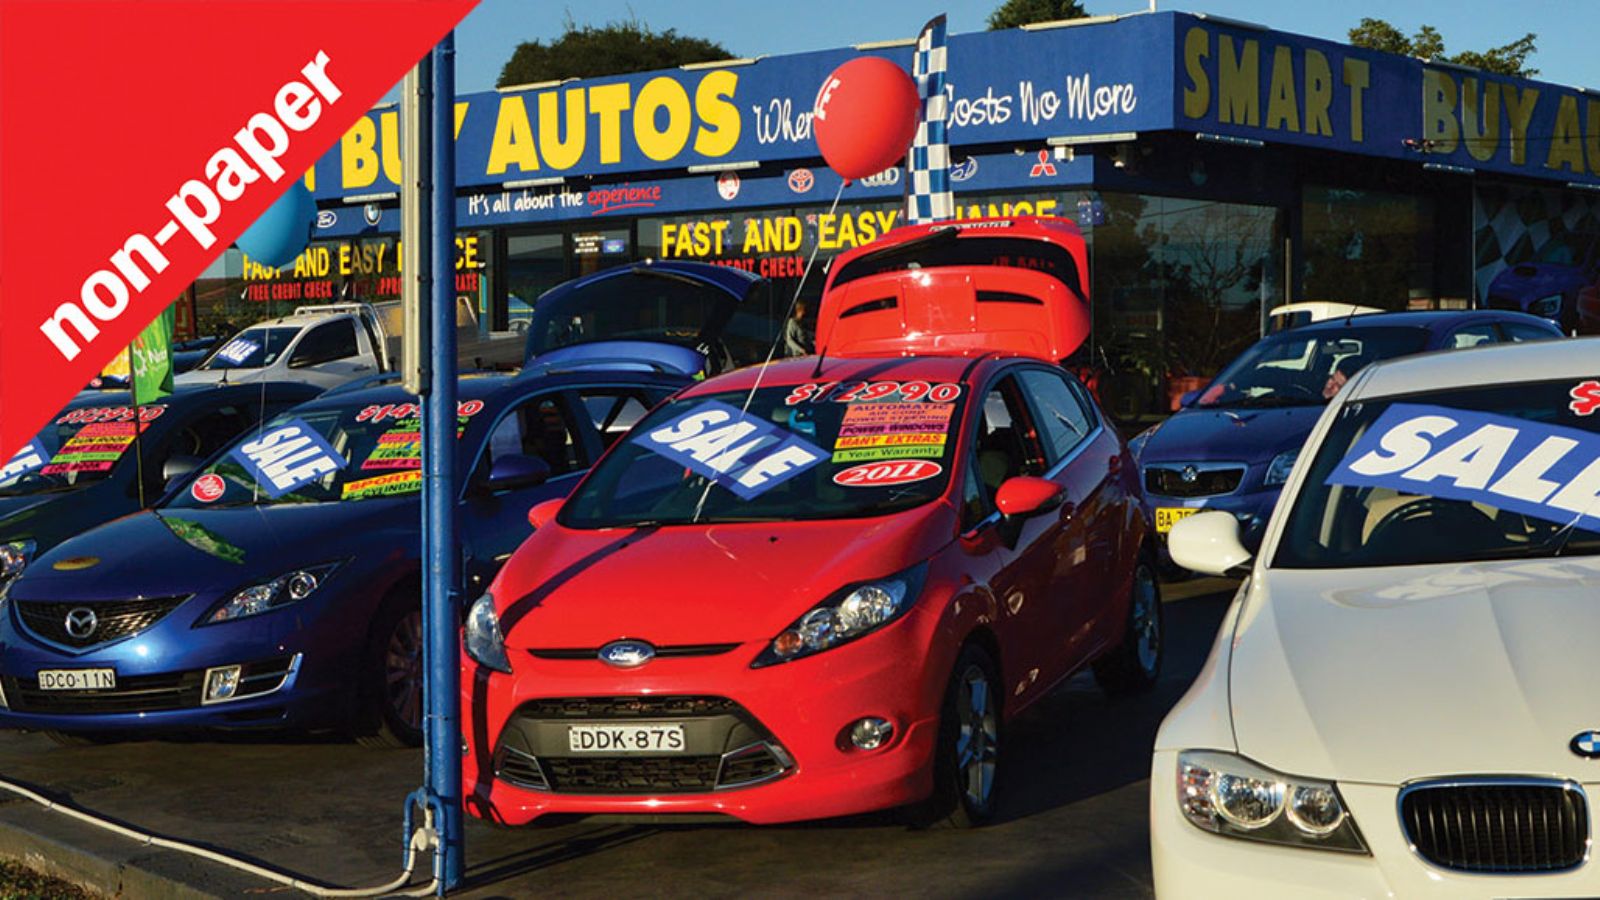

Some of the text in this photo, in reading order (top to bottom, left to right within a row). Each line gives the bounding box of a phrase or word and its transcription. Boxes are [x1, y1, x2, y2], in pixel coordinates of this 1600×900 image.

[1020, 80, 1061, 126] No
[1067, 73, 1137, 122] More
[1184, 27, 1370, 143] SMART
[1423, 68, 1539, 167] BUY
[486, 70, 742, 176] AUTOS
[469, 182, 661, 215] It's all about the experience
[661, 210, 898, 258] FAST AND EASY
[294, 246, 330, 278] AND
[339, 243, 386, 276] EASY
[760, 256, 804, 278] CHECK
[249, 284, 269, 301] FREE
[272, 282, 302, 300] CREDIT
[304, 280, 333, 298] CHECK
[784, 380, 961, 406] $12990
[855, 403, 948, 412] AUTOMATIC
[840, 433, 940, 447] MANY EXTRAS
[843, 422, 944, 434] POWER WINDOWS
[241, 426, 338, 490] SALE
[650, 408, 818, 489] SALE
[849, 450, 876, 458] Year
[882, 446, 939, 458] Warranty
[845, 463, 921, 482] 2011
